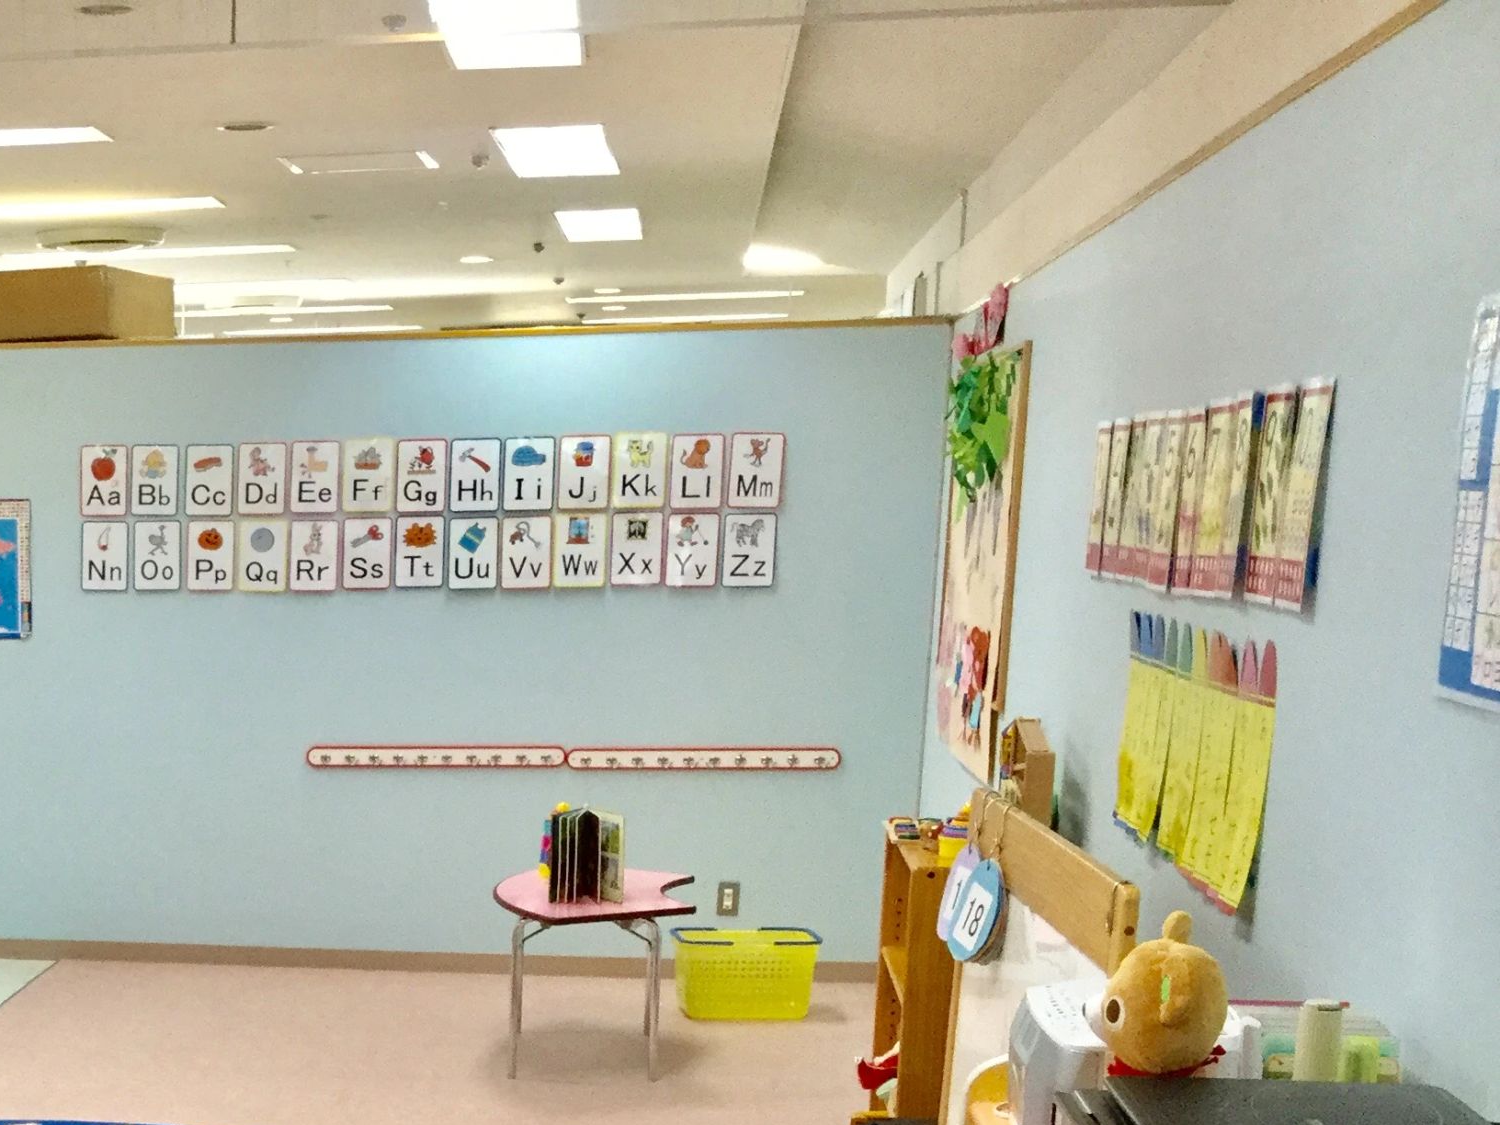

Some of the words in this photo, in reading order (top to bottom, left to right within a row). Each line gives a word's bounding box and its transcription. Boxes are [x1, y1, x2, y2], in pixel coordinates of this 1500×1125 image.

[87, 484, 120, 506] Aa
[139, 484, 170, 506] Bb
[191, 484, 226, 506] Cc
[245, 482, 277, 505] Dd
[298, 481, 332, 503] Ee
[353, 479, 384, 501] Ff
[403, 480, 437, 506] Gg
[458, 479, 493, 501] Hh
[568, 476, 597, 503] Jj
[621, 474, 657, 497] Kk
[681, 475, 711, 498] Ll
[737, 475, 773, 498] Mm
[88, 560, 122, 581] Nn
[141, 560, 173, 581] Oo
[195, 559, 227, 584] Pp
[245, 561, 278, 584] Qq
[296, 559, 329, 581] Rr
[350, 557, 384, 579] Ss
[404, 555, 435, 577] Tt
[454, 558, 489, 580] Uu
[509, 556, 543, 578] Vv
[562, 554, 598, 576] Ww
[617, 552, 653, 575] Xx
[674, 553, 707, 579] Yy
[730, 554, 766, 577] Zz
[963, 898, 985, 937] 18
